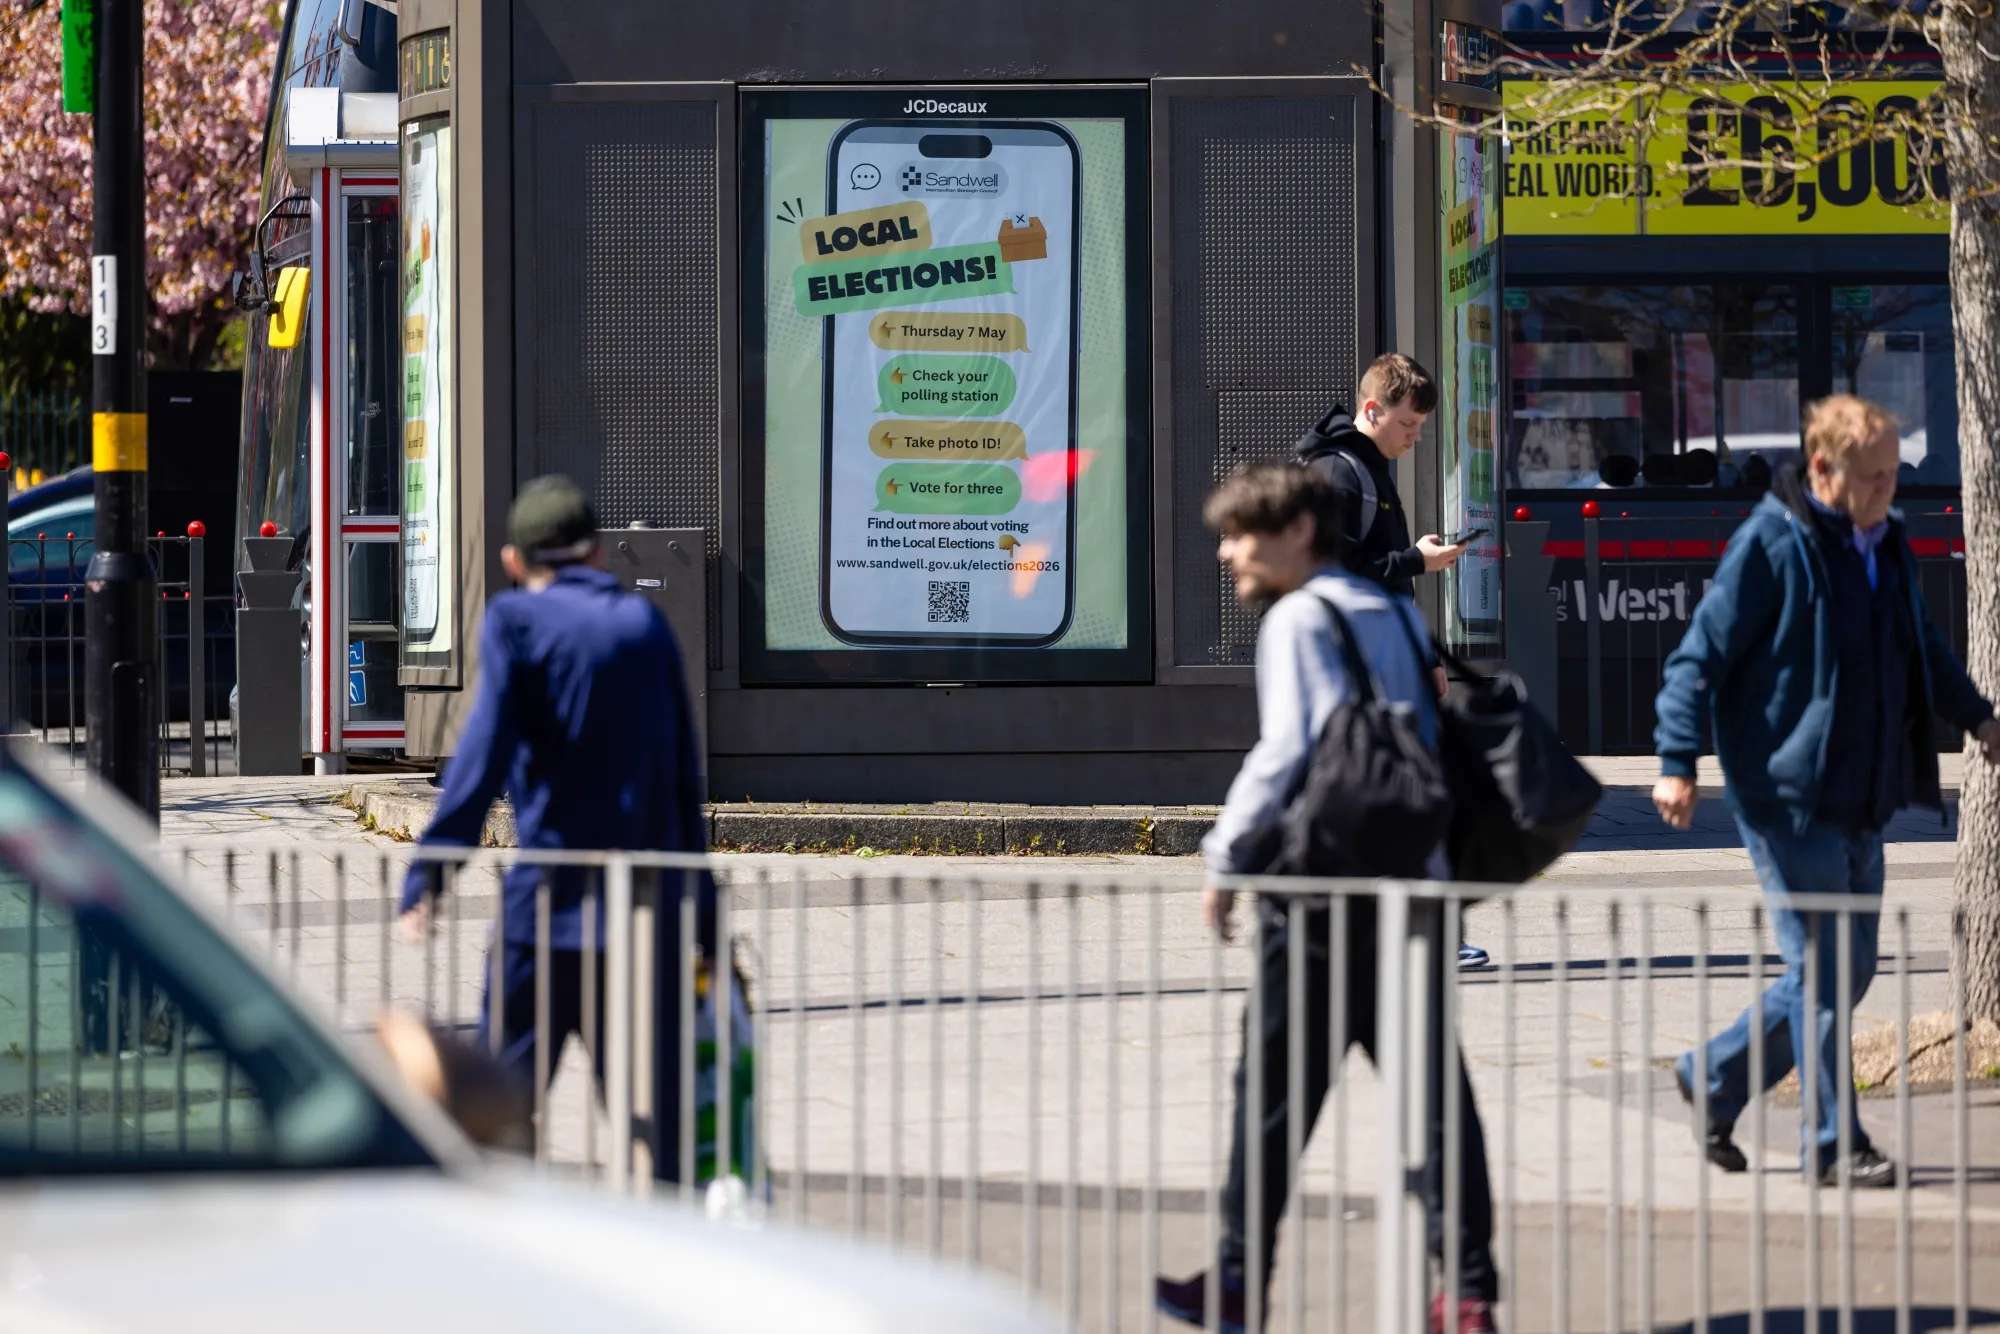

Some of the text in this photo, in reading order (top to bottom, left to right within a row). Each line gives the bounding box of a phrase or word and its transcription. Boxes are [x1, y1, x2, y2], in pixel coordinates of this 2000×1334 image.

[903, 99, 987, 114] JCDecaux
[926, 172, 998, 186] Sandwell
[1554, 162, 1661, 197] WORLD.
[814, 215, 918, 256] LOCAL
[1450, 210, 1477, 248] LOCAL
[807, 255, 997, 302] ELECTIONS!
[901, 324, 1006, 342] Thursday 7 May
[912, 369, 989, 385] Check your
[901, 388, 999, 404] polling station
[904, 436, 1001, 452] Take photo ID!
[910, 482, 1004, 495] Vote for three
[867, 518, 1029, 534] Find out more about voting
[867, 537, 995, 550] in the Local Elections
[836, 558, 1060, 572] www.sandwell.gov.uk/elections2026
[1573, 579, 1690, 622] West
